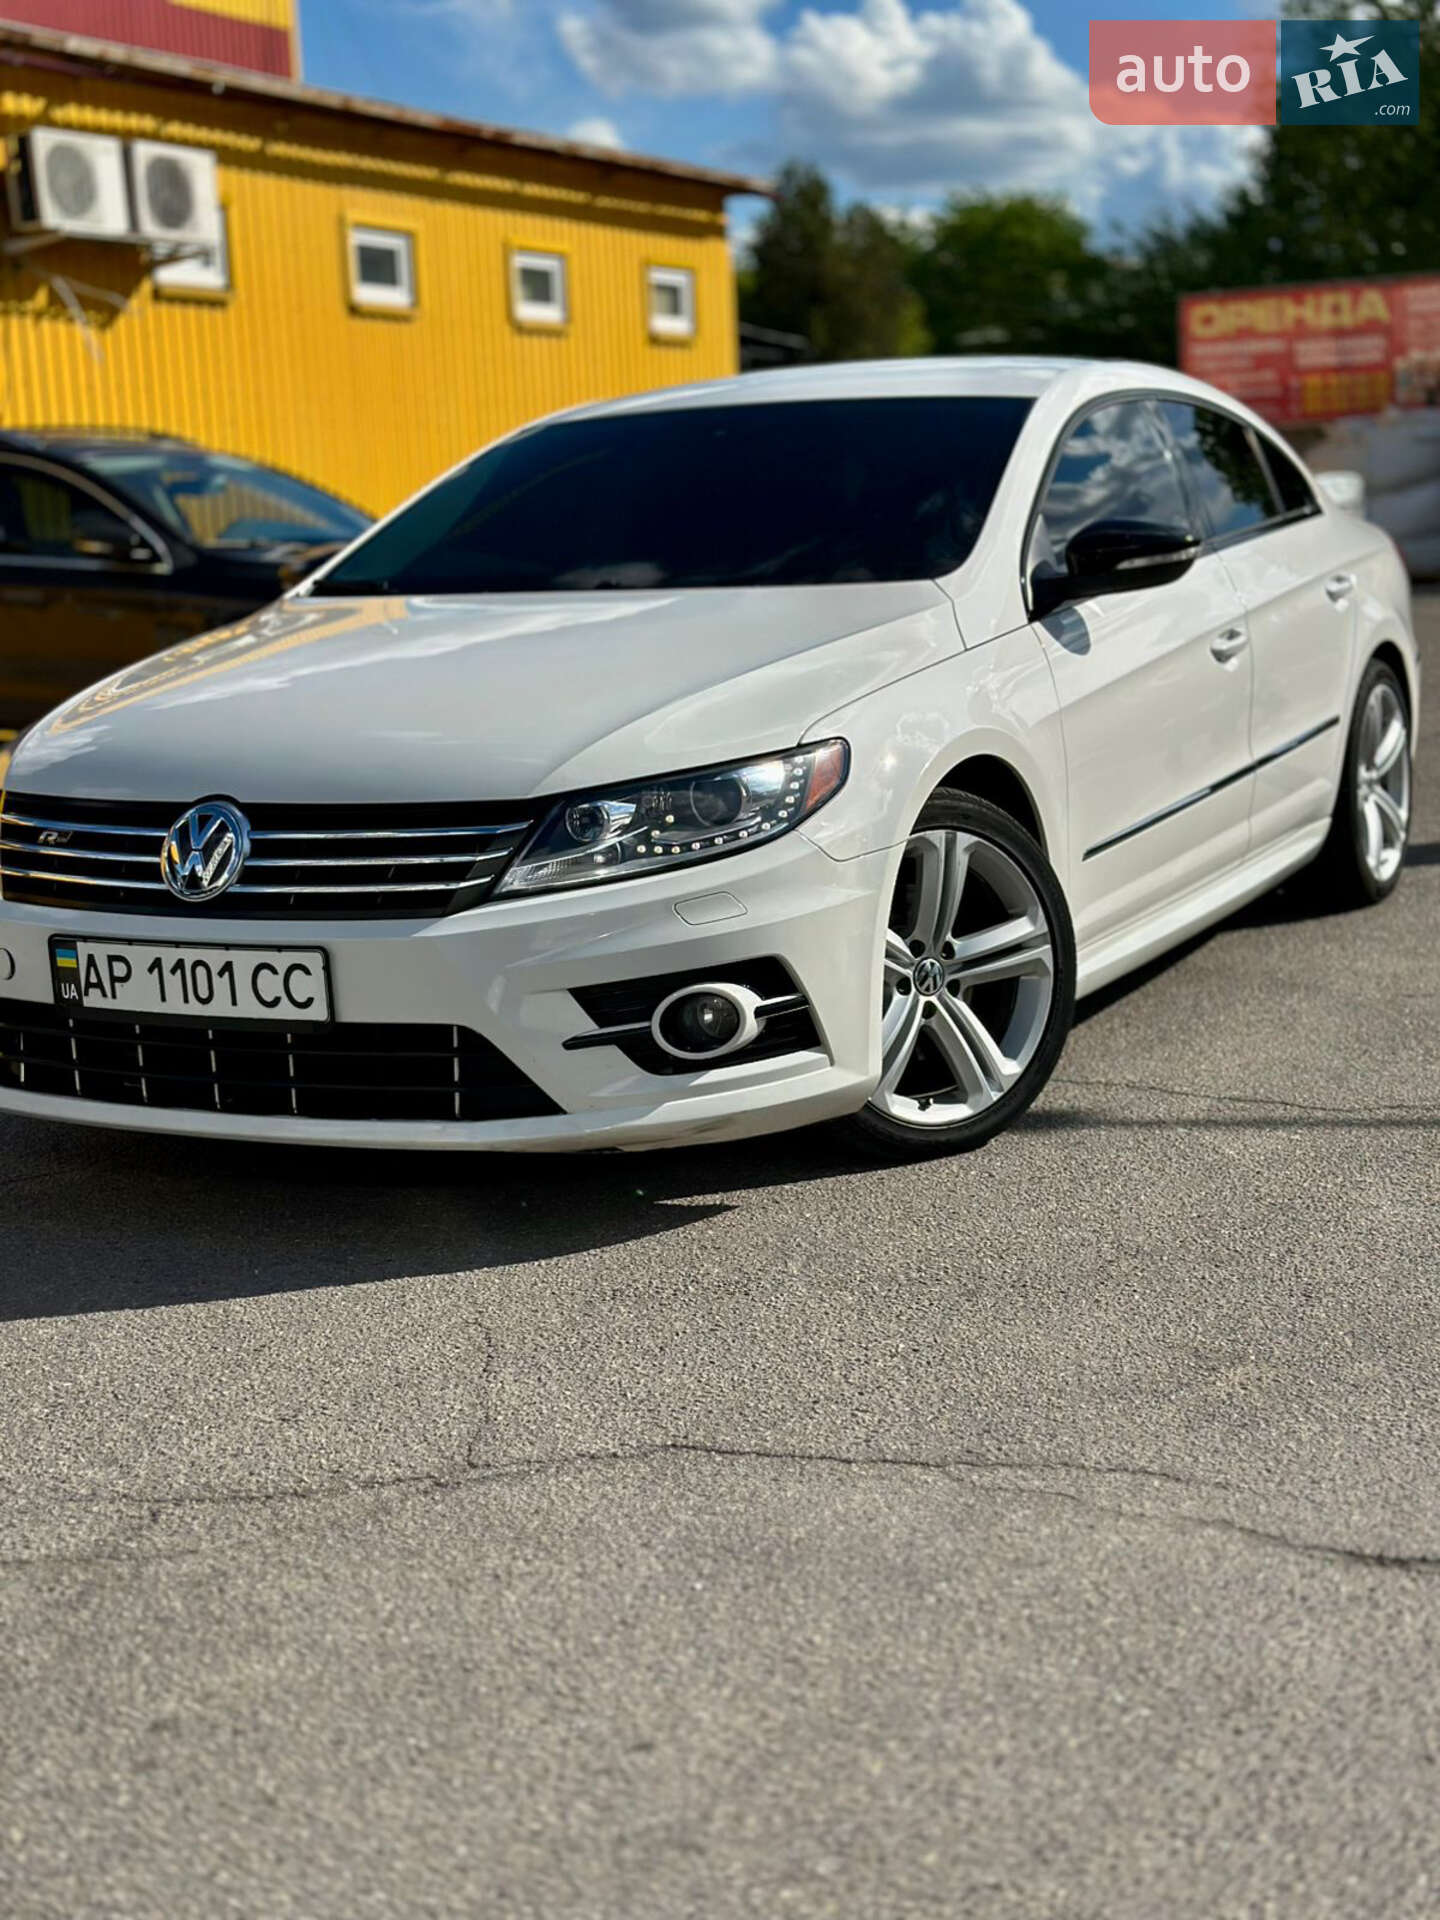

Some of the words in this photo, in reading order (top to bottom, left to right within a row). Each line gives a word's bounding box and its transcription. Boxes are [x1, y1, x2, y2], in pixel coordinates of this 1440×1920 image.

[61, 983, 80, 1001] UA
[83, 953, 133, 1000] AP
[147, 956, 238, 1007] 1101
[251, 962, 315, 1010] CC
